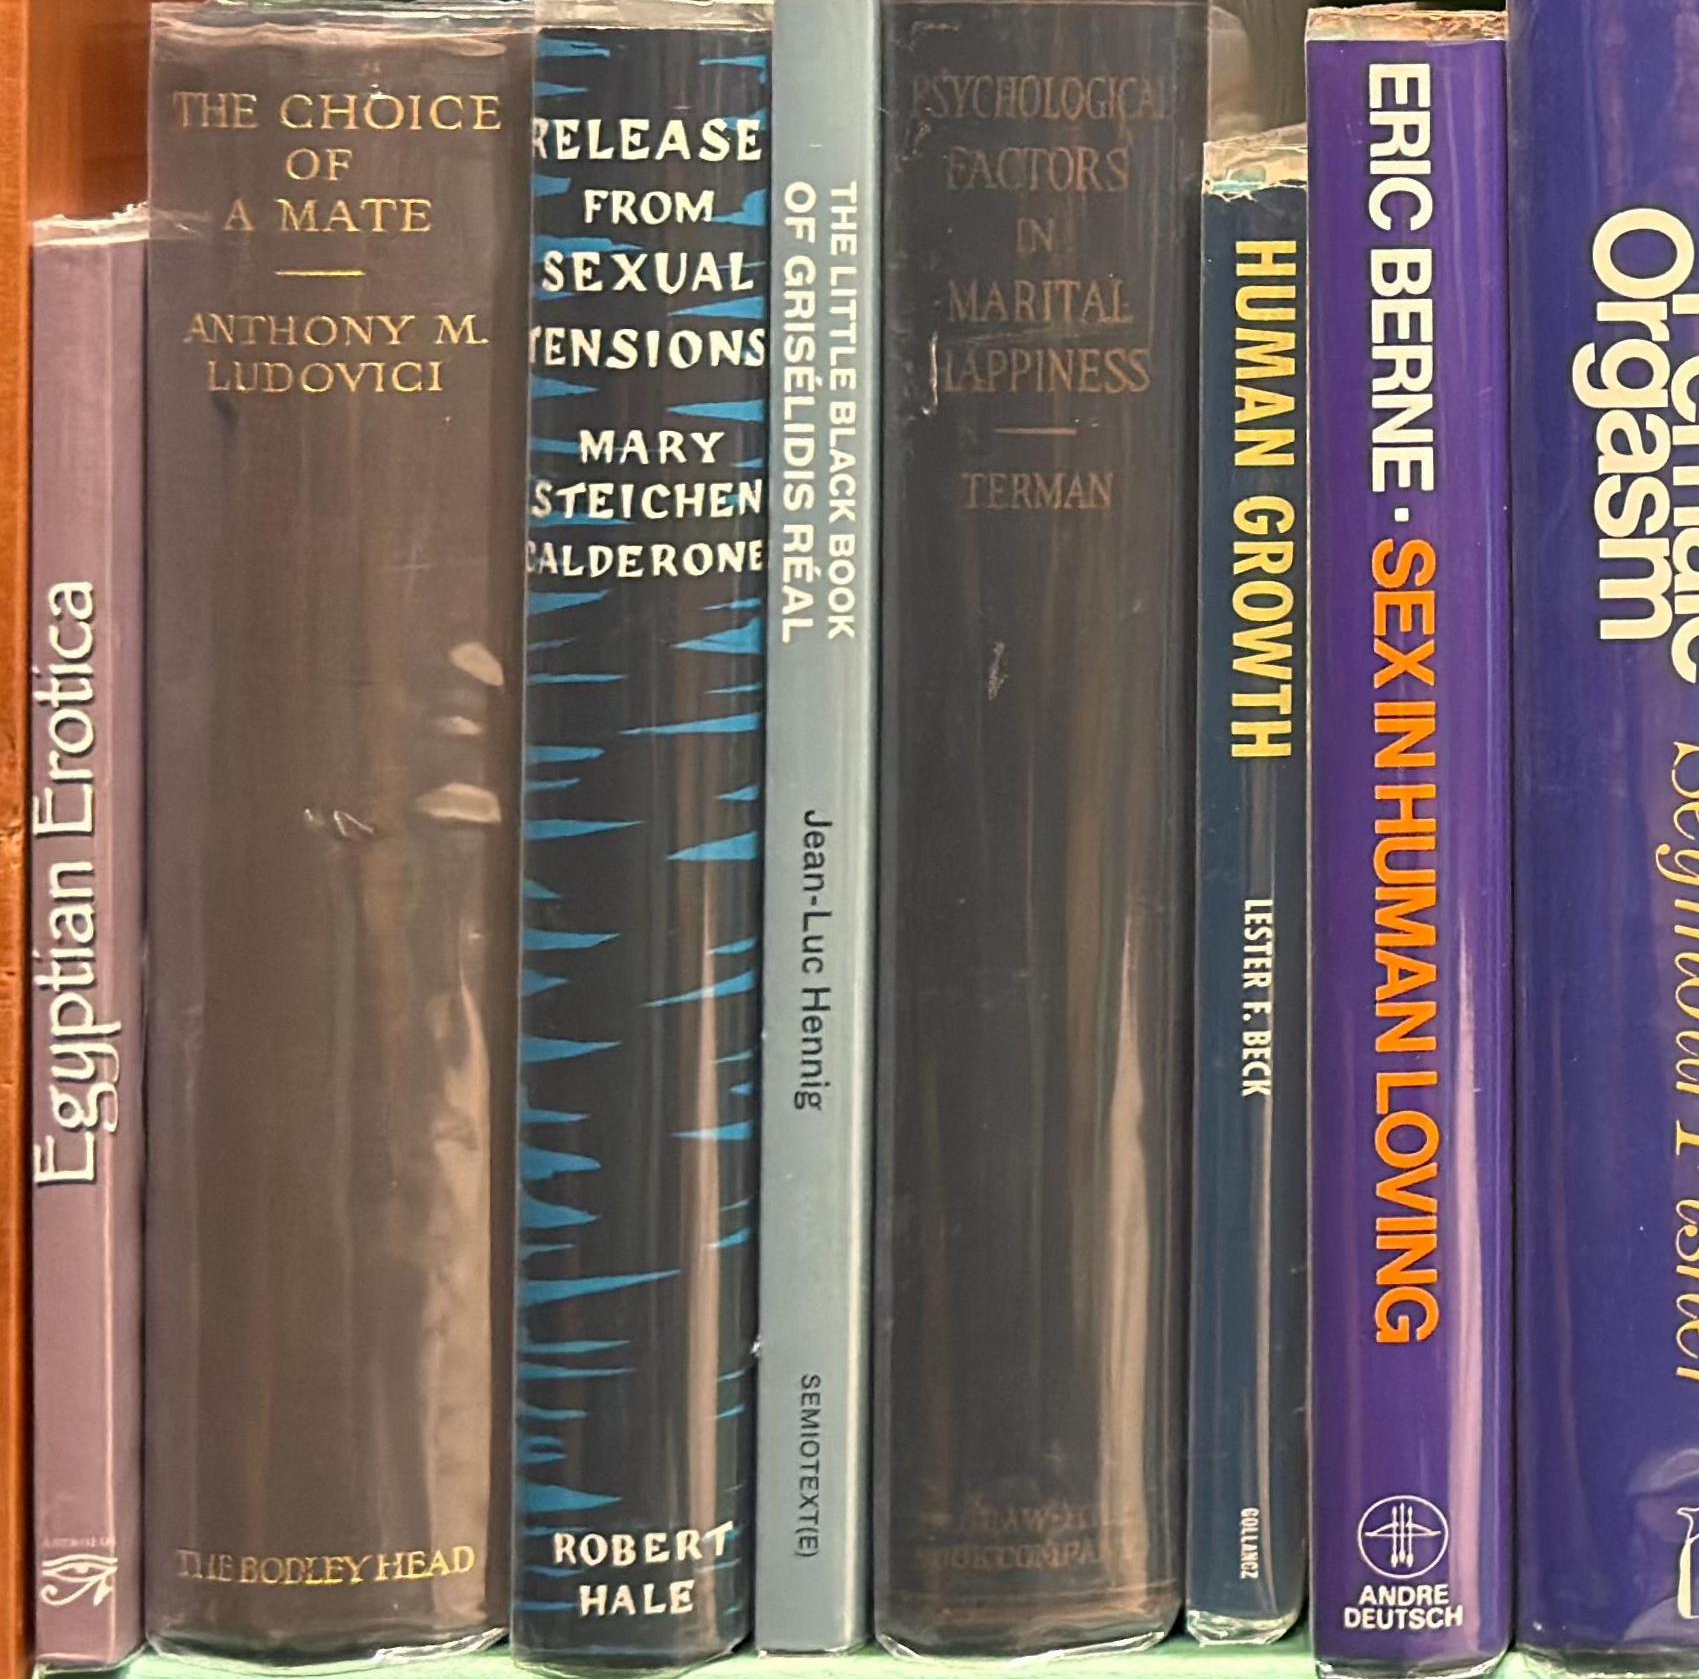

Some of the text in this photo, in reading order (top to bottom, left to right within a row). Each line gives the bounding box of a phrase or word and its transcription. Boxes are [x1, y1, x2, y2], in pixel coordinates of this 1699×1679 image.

[174, 93, 502, 131] THE CHOICE
[532, 118, 762, 162] RELEASE
[948, 146, 1129, 192] FACTORS
[583, 190, 715, 224] FROM
[541, 250, 755, 294] SEXUAL
[949, 278, 1133, 323] MARITAL
[184, 313, 490, 347] ANTHONY M.
[207, 359, 443, 394] LUDOVICI
[826, 180, 858, 640] THE LITTLE BLACK BOOK
[1573, 207, 1695, 641] Orgasm
[578, 429, 725, 465] MARY
[531, 478, 763, 519] STEICHEN
[960, 471, 1113, 510] TERMAN
[525, 539, 764, 579] CALDERONE
[1369, 63, 1439, 1344] ERIC BERNE SEX IN HUMAN LOVING
[33, 578, 121, 1188] Egyptian Erotica
[793, 810, 833, 1112] Jean-Luc Hennig
[1241, 899, 1273, 1097] LESTER F. BECK
[796, 1372, 822, 1559] SEMIOTEXT(E)
[177, 1544, 476, 1587] THE BODLEY HEAD
[553, 1521, 734, 1566] ROBERT
[1239, 1508, 1259, 1580] GOLLANCZ
[580, 1581, 695, 1617] HALE
[1343, 1604, 1463, 1630] DEUTSCH
[1358, 1583, 1450, 1607] ANDRE
